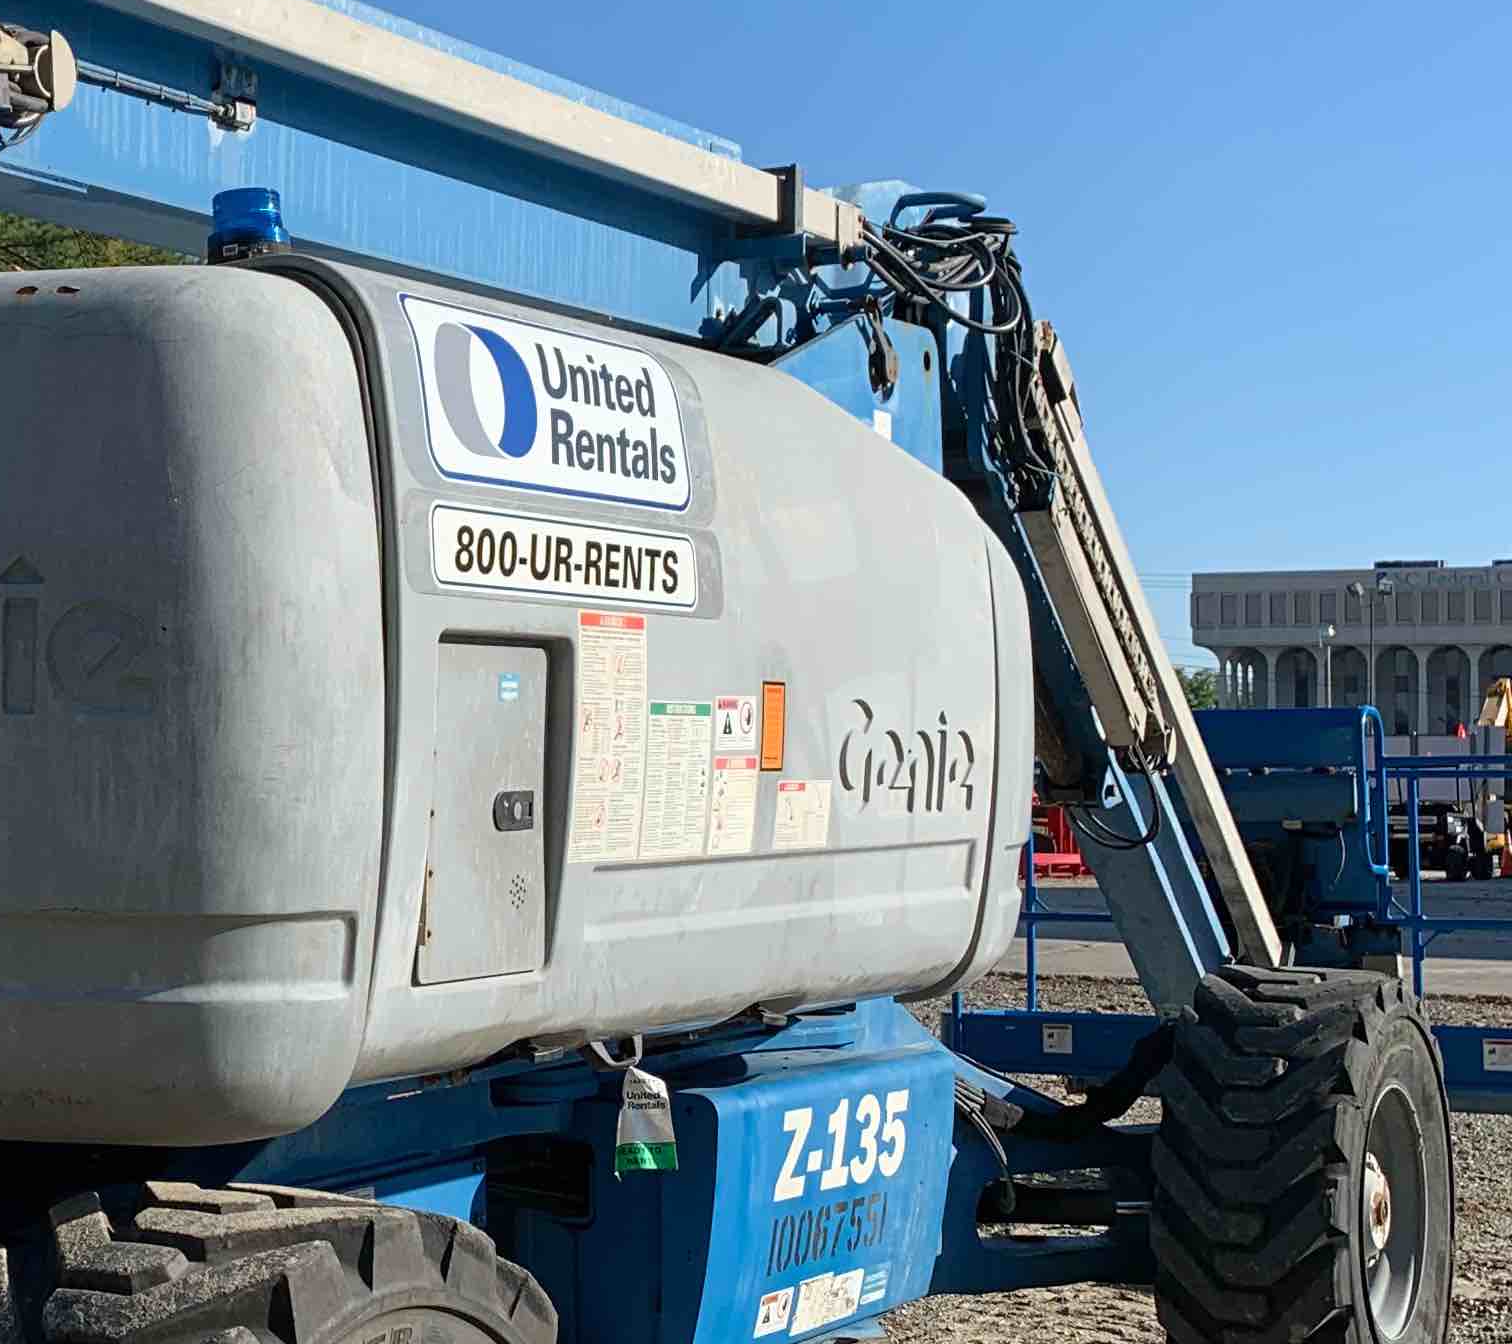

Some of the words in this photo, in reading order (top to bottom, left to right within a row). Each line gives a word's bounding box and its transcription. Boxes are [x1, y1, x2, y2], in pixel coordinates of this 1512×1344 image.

[534, 343, 657, 418] United
[550, 408, 677, 485] Rentals
[454, 524, 679, 595] 800-UR-RENTS
[626, 1090, 661, 1100] United
[773, 1088, 910, 1203] Z-135
[766, 1191, 888, 1277] 10067551
